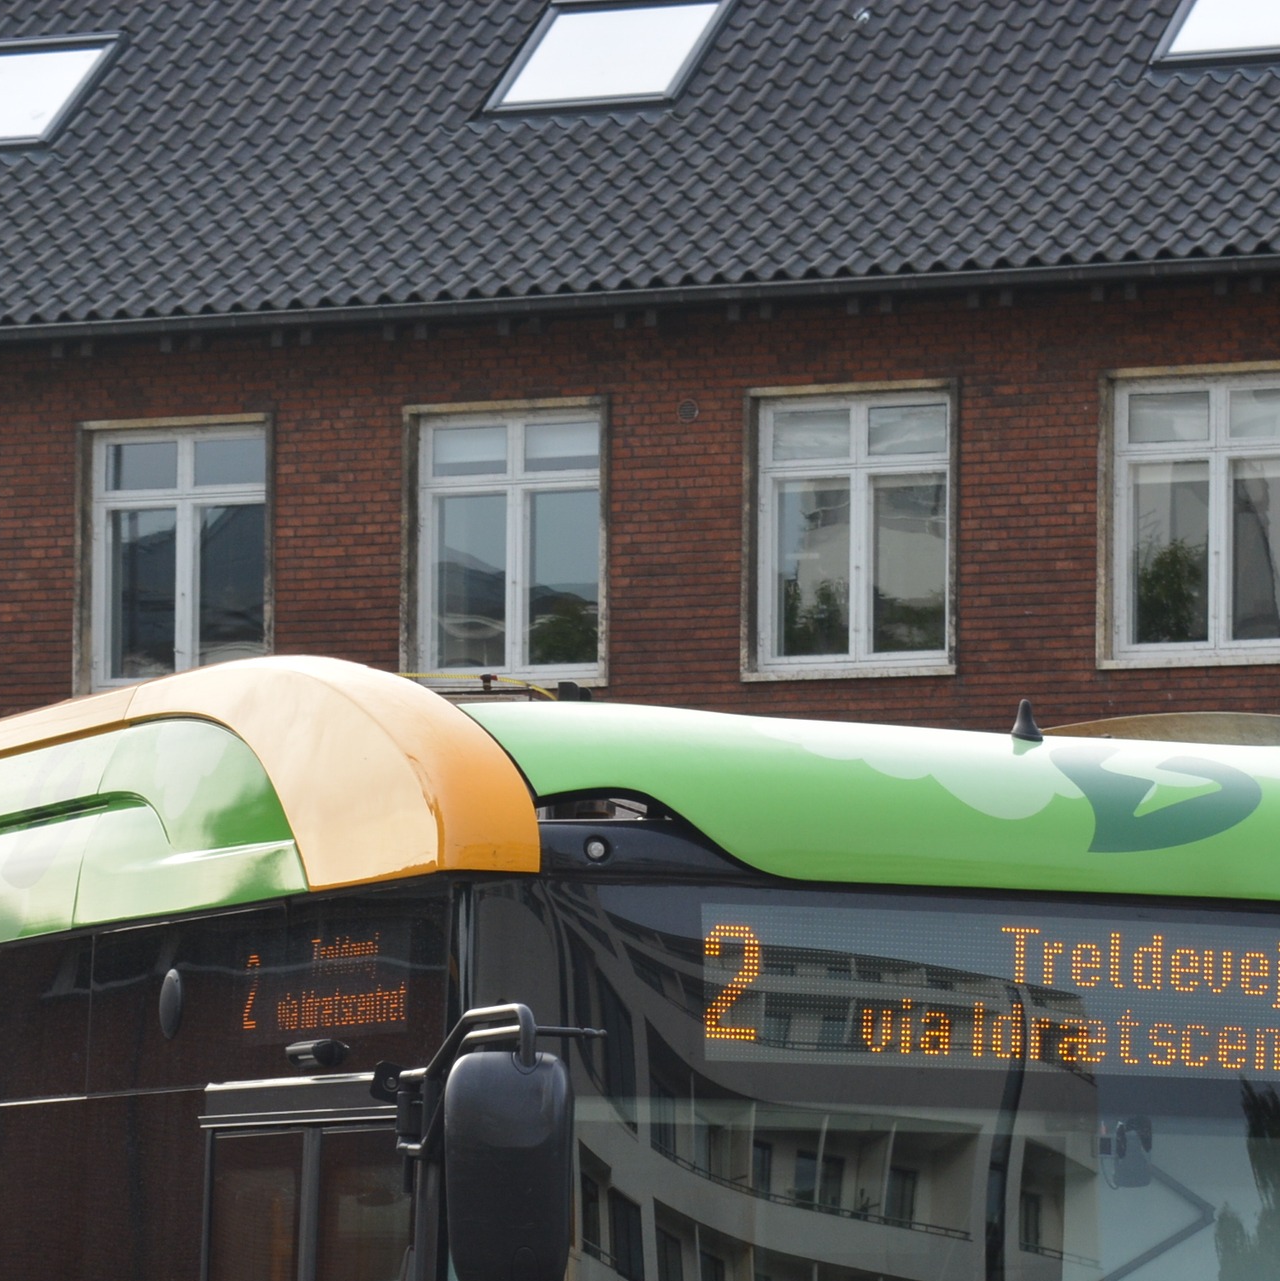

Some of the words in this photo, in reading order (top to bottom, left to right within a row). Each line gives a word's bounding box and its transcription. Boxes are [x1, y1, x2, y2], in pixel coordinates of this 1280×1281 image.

[311, 932, 380, 979] Treldevej
[704, 924, 760, 1041] 2
[242, 953, 261, 1030] 2
[278, 992, 299, 1031] via
[300, 980, 407, 1029] Idrætscentret
[861, 998, 950, 1056] via
